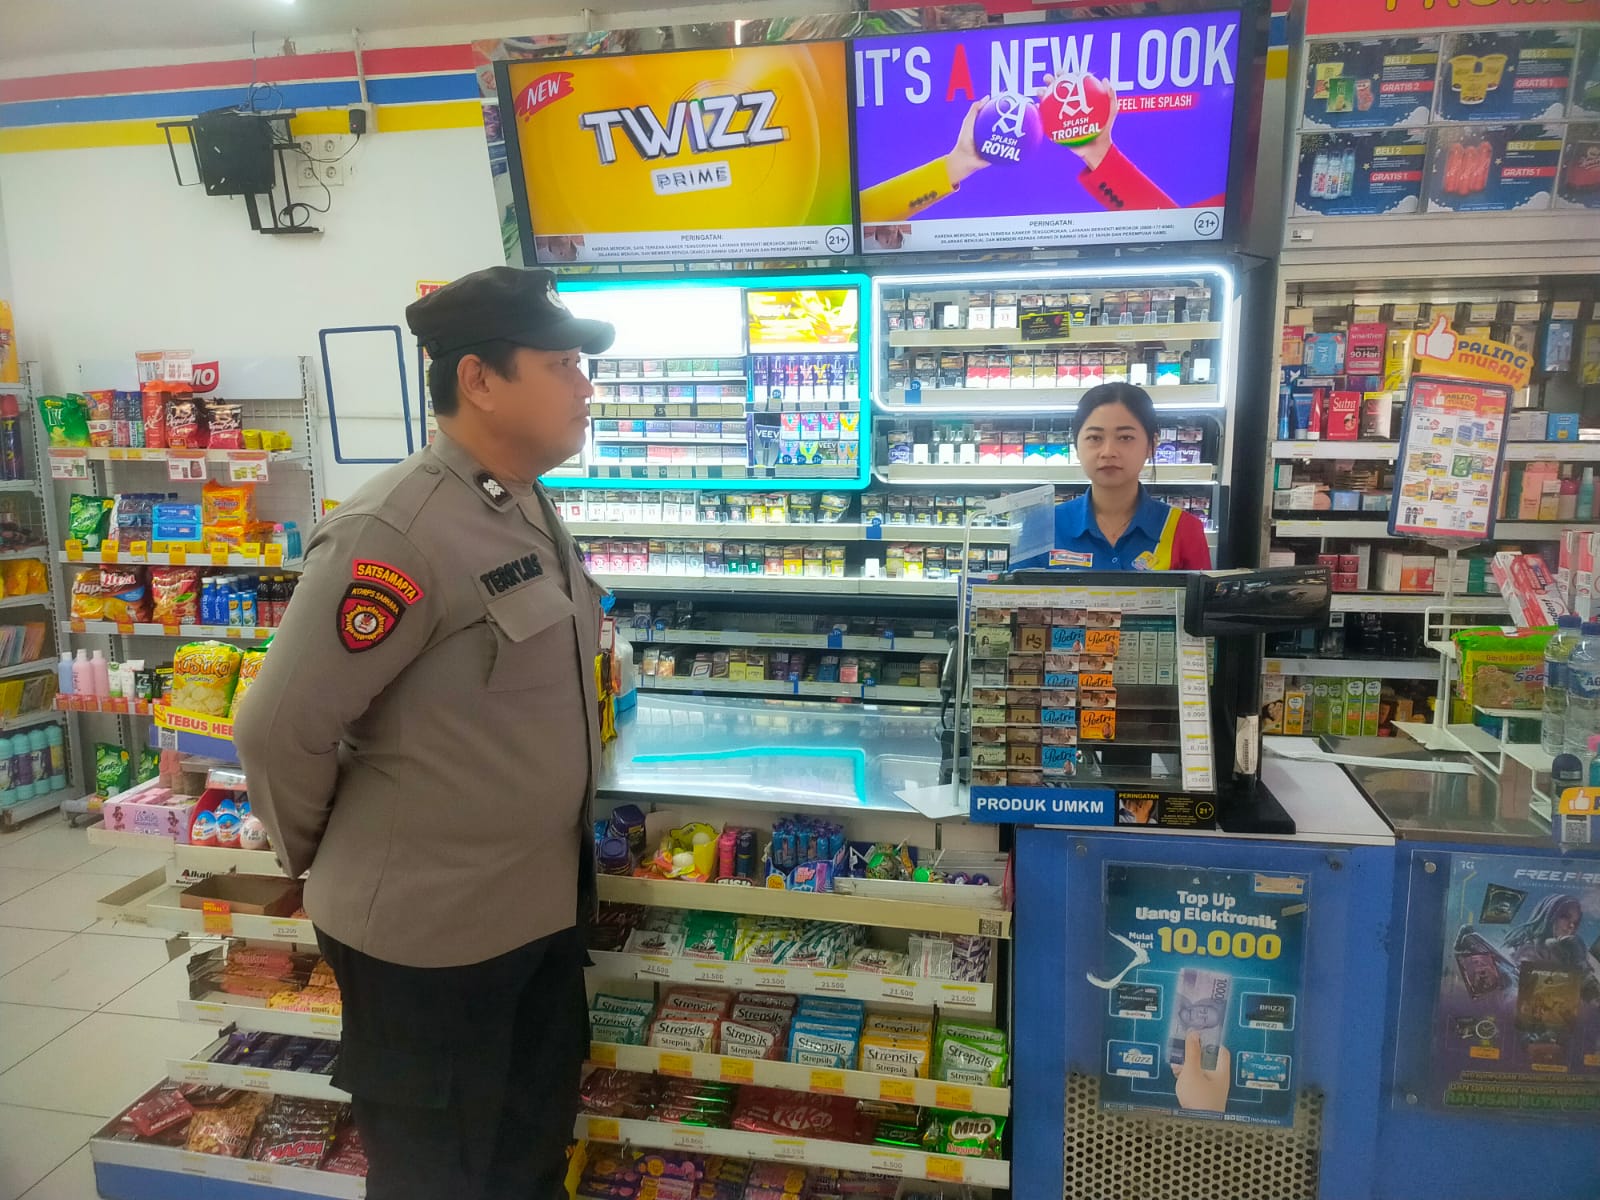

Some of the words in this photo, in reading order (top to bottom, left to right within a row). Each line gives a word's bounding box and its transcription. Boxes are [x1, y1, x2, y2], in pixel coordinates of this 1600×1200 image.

[855, 46, 931, 107] IT'S
[946, 43, 974, 101] A
[990, 34, 1094, 98] NEW
[1112, 24, 1237, 90] LOOK
[1382, 82, 1412, 92] GRATIS
[1414, 82, 1420, 91] 2
[1516, 80, 1548, 88] GRATIS
[526, 74, 562, 110] NEW
[1118, 97, 1138, 110] FEEL
[1140, 96, 1156, 109] THE
[1158, 94, 1192, 108] SPLASH
[579, 90, 790, 165] TWIZZ
[1063, 117, 1089, 128] SPLASH
[1052, 122, 1101, 141] TROPICAL
[990, 134, 1018, 147] SPLASH
[1508, 142, 1529, 150] BELI
[1530, 142, 1536, 150] 2
[981, 140, 1021, 162] ROYAL
[656, 166, 729, 190] PRIME
[1372, 173, 1403, 181] GRATIS
[1504, 168, 1535, 177] GRATIS
[1198, 219, 1216, 229] 21+
[829, 235, 846, 245] 21+
[1458, 340, 1529, 370] PALING
[1458, 352, 1525, 384] MURAH
[1333, 397, 1357, 410] Sutra
[756, 430, 780, 438] VEEV
[357, 564, 418, 600] SATSAMAPTA
[166, 713, 208, 731] TEBUS
[1083, 711, 1114, 728] Poetri
[1118, 792, 1160, 801] PERINGATAN
[976, 797, 1047, 812] PRODUK
[1052, 799, 1104, 815] UMKM
[1514, 868, 1562, 881] FREE
[1177, 890, 1209, 907] Top
[1212, 892, 1236, 909] Up
[1136, 907, 1181, 924] Uang
[1184, 907, 1278, 930] Elektronik
[1128, 931, 1154, 941] Mulai
[1156, 926, 1282, 960] 10.000
[1134, 940, 1154, 949] dari
[738, 1008, 784, 1023] Strepsils
[1259, 1004, 1286, 1013] BRIZZI
[659, 1022, 706, 1037] Strepsils
[726, 1026, 768, 1047] Strepsils
[661, 1037, 691, 1048] Strepsils
[798, 1036, 848, 1055] Strepsils
[730, 1046, 761, 1057] Strepsils
[867, 1049, 919, 1065] Strepsils
[949, 1045, 994, 1069] Strepsils
[801, 1053, 833, 1065] Strepsils
[875, 1063, 908, 1074] Strepsils
[950, 1071, 984, 1082] Strepsils
[954, 1121, 992, 1135] MILO
